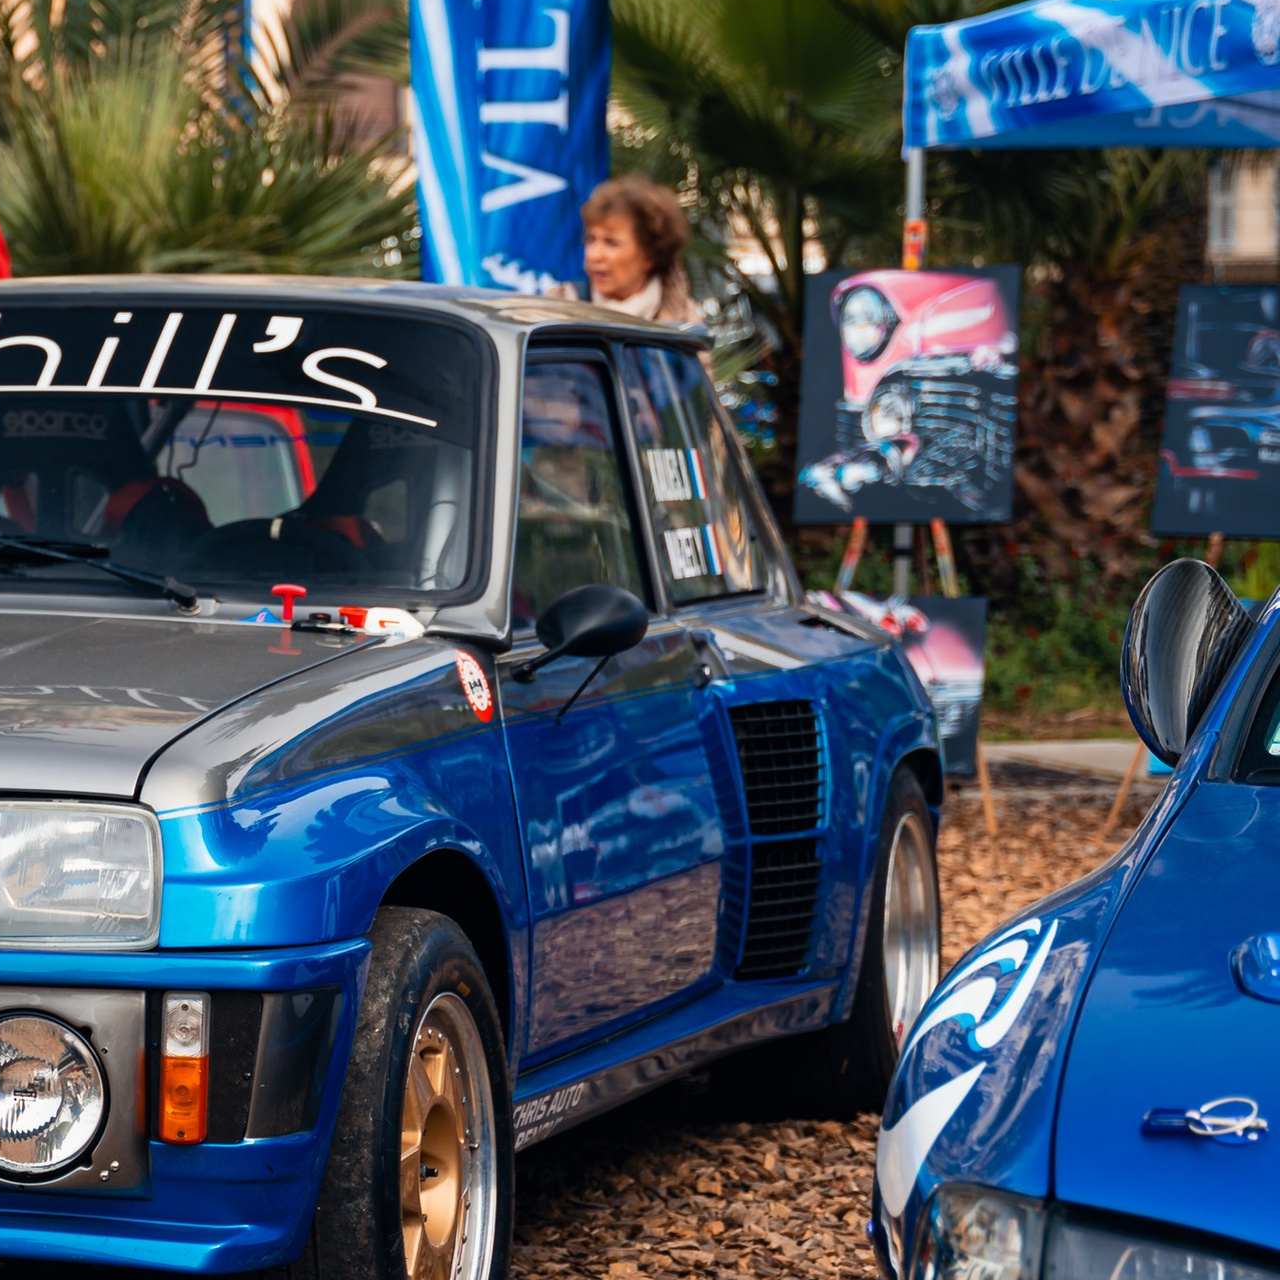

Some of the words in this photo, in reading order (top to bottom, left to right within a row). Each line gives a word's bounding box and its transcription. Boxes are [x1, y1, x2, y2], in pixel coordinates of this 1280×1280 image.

[980, 37, 1071, 108] VILLE
[1078, 18, 1132, 97] DE
[513, 1094, 552, 1129] CHRIS
[546, 1082, 585, 1117] AUTO
